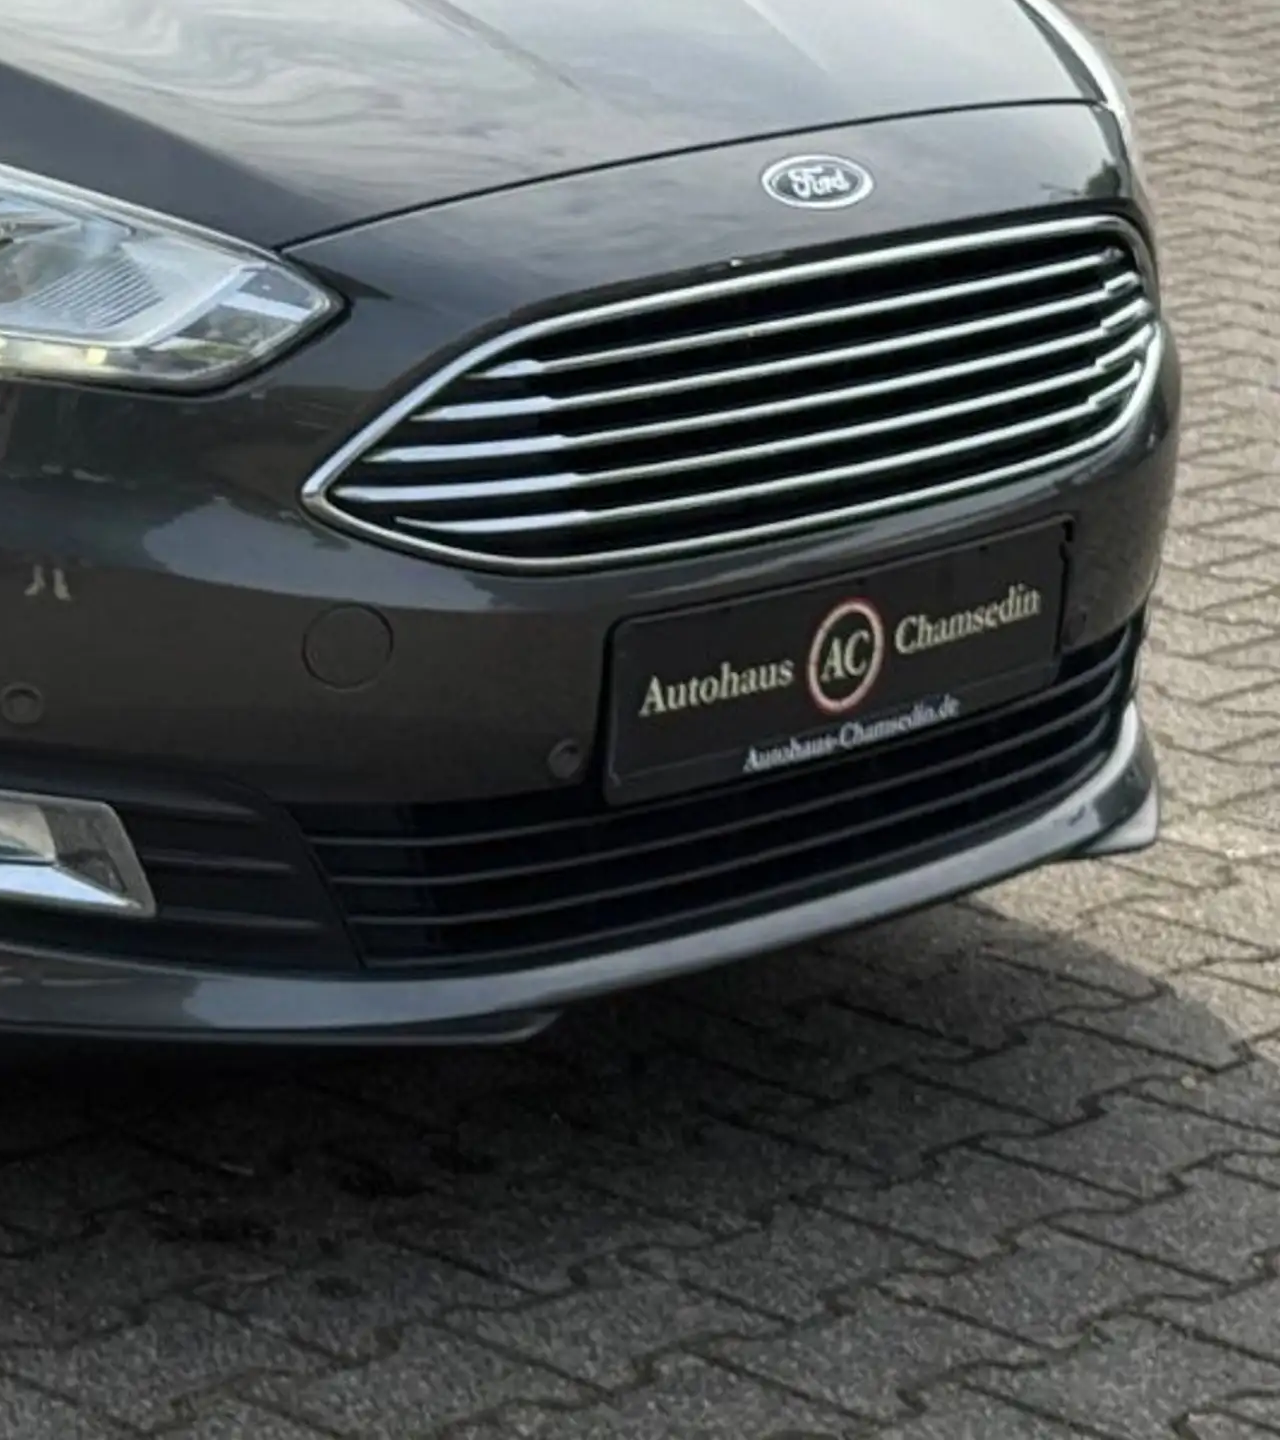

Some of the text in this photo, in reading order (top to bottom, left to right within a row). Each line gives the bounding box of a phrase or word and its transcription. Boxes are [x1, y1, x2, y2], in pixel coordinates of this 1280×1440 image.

[787, 164, 851, 199] Ford
[639, 582, 1041, 717] Autohaus AC Chamsedin
[742, 693, 961, 773] Autohaus-Chamsedin.de
